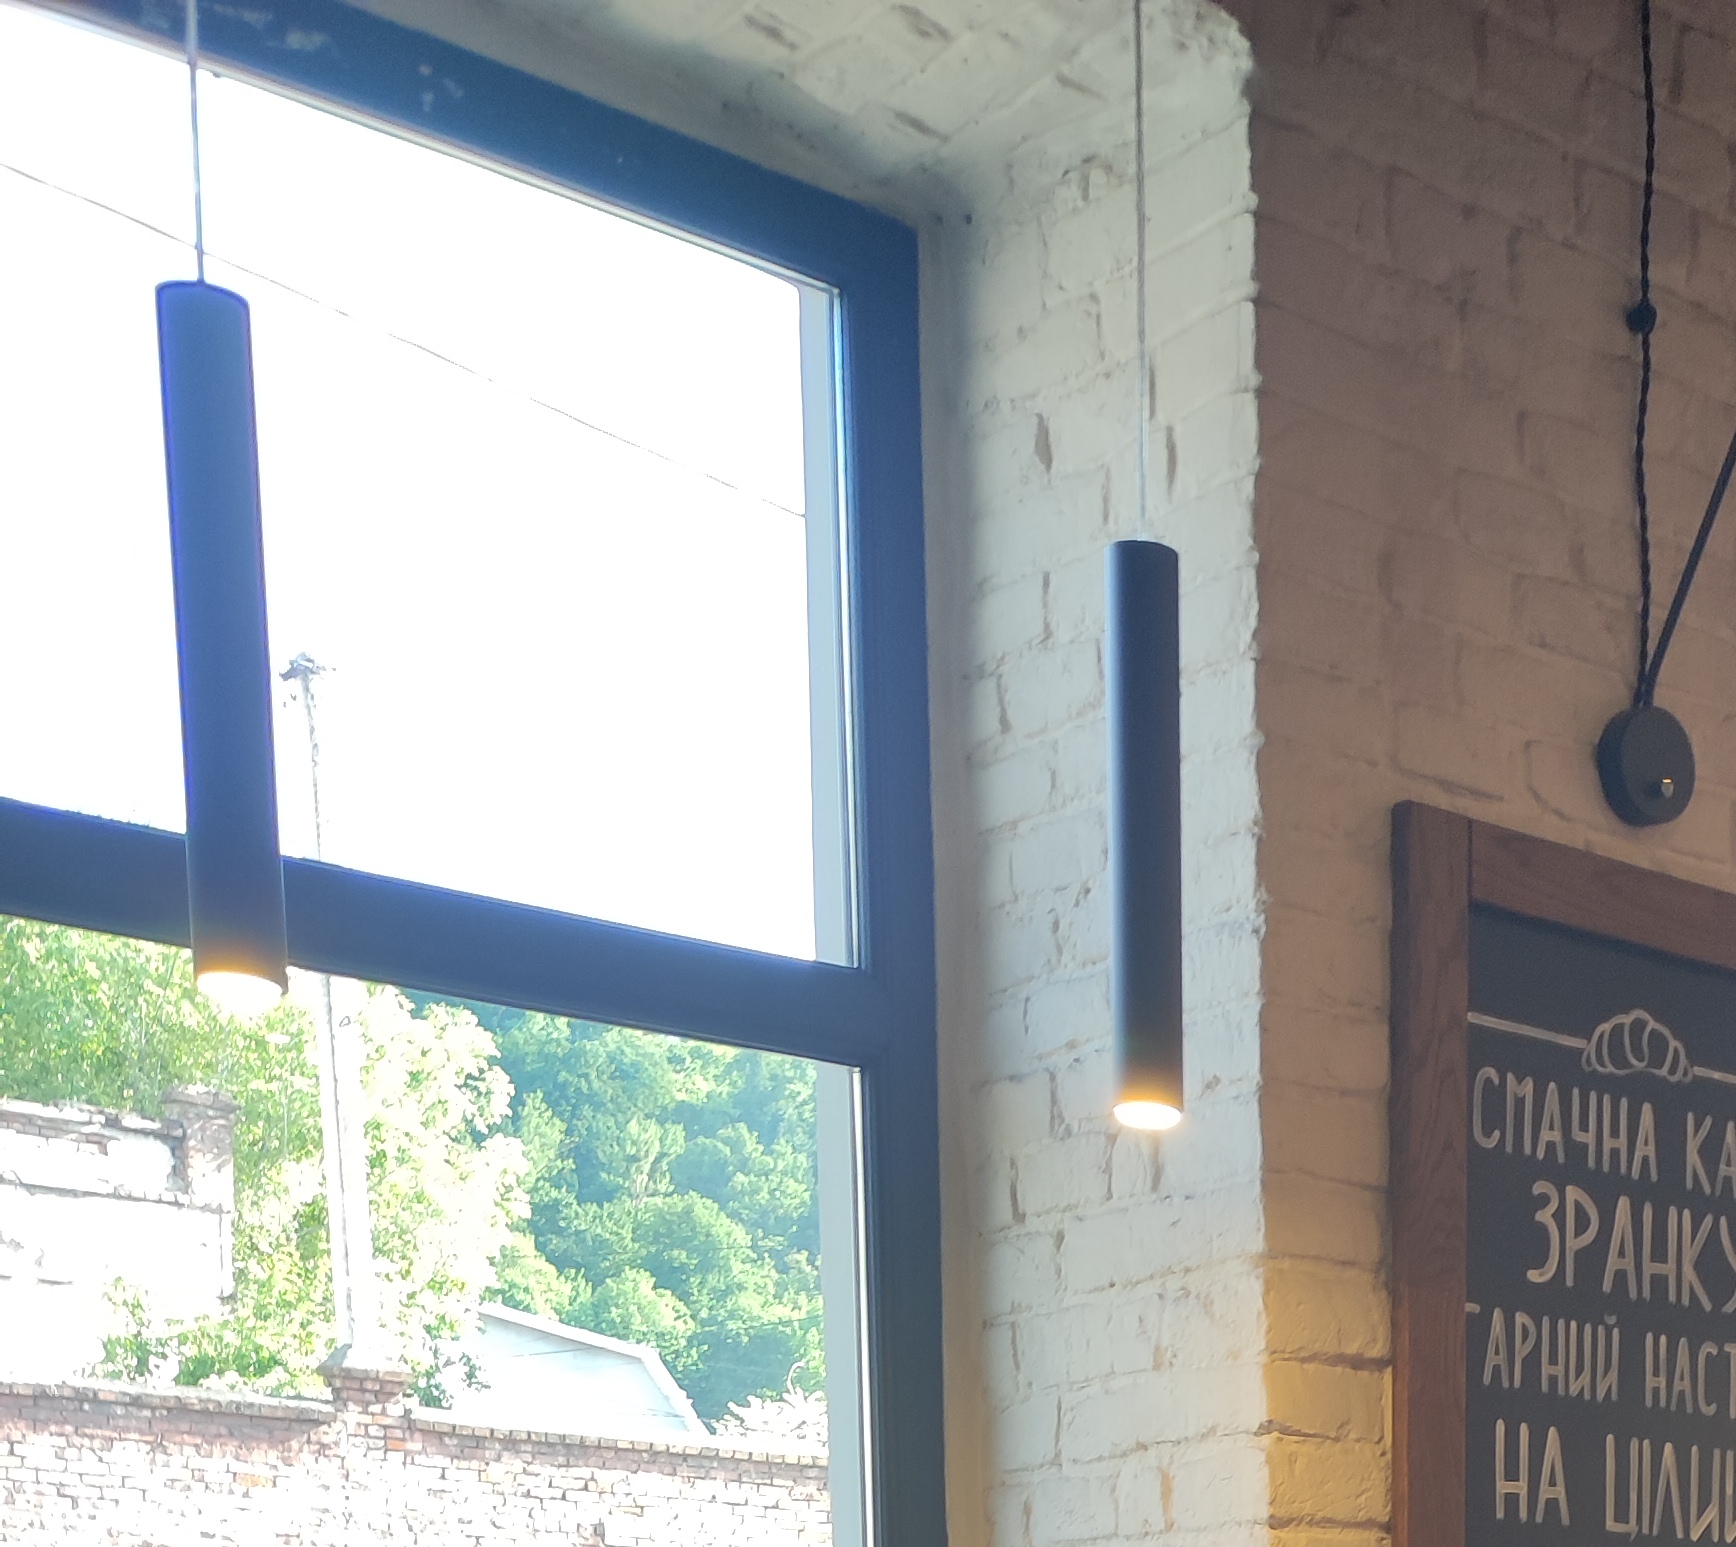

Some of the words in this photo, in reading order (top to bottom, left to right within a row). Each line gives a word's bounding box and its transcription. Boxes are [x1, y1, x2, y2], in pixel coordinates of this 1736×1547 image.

[1472, 1066, 1658, 1183] СМАЧНА
[1464, 1302, 1620, 1403] АРНИЙ
[1495, 1418, 1570, 1528] НА
